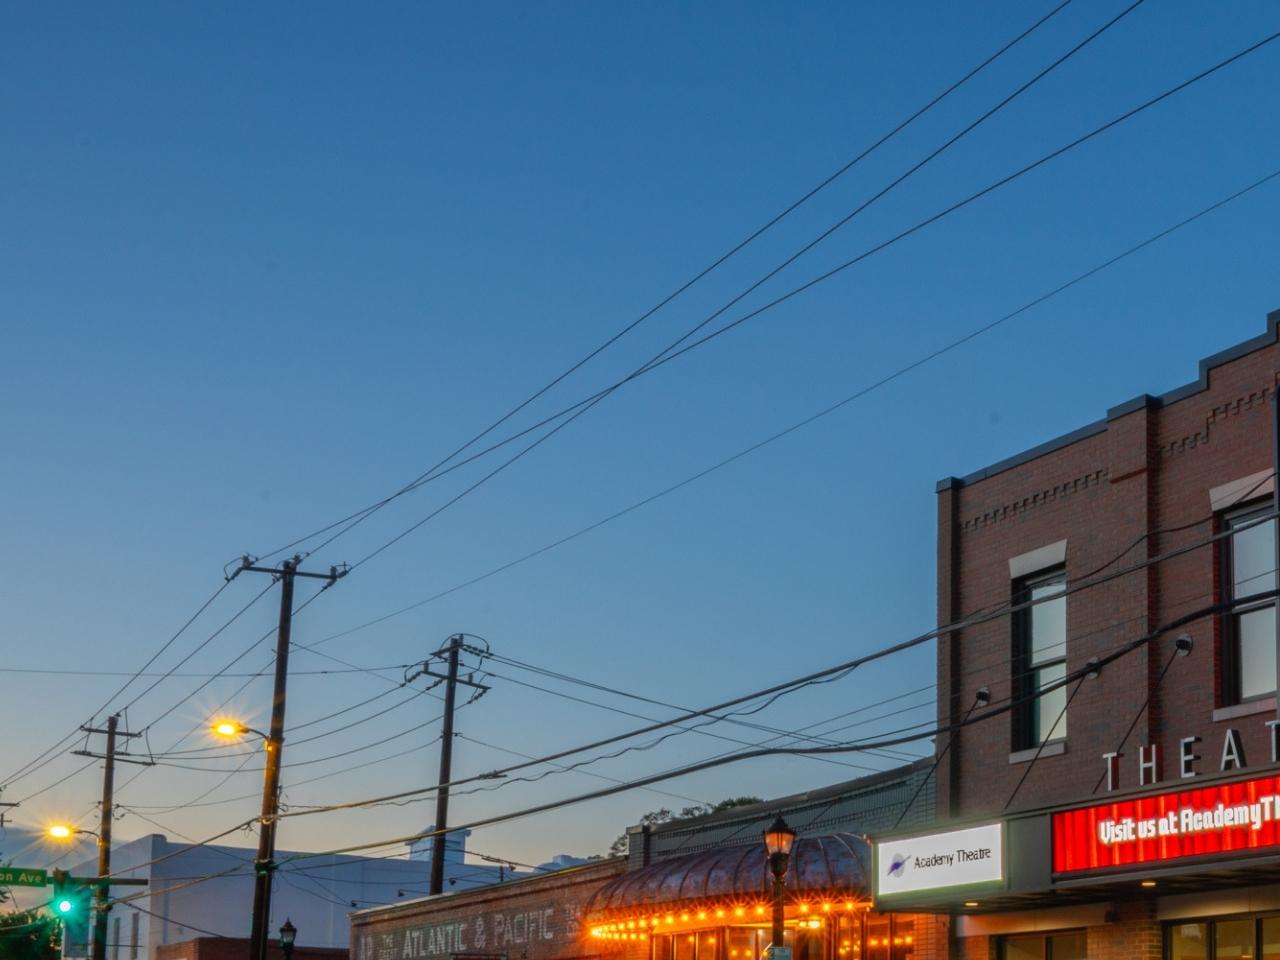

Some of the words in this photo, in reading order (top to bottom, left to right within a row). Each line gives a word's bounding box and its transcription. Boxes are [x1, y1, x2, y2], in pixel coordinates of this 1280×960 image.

[1099, 814, 1136, 844] Visit
[1138, 819, 1157, 839] us
[1158, 812, 1178, 836] at
[914, 853, 954, 869] Academy
[957, 847, 991, 863] Theatre
[18, 872, 42, 884] Ave
[402, 922, 468, 959] ATLANTIC
[473, 917, 486, 949] &
[494, 908, 555, 947] PACIFIC
